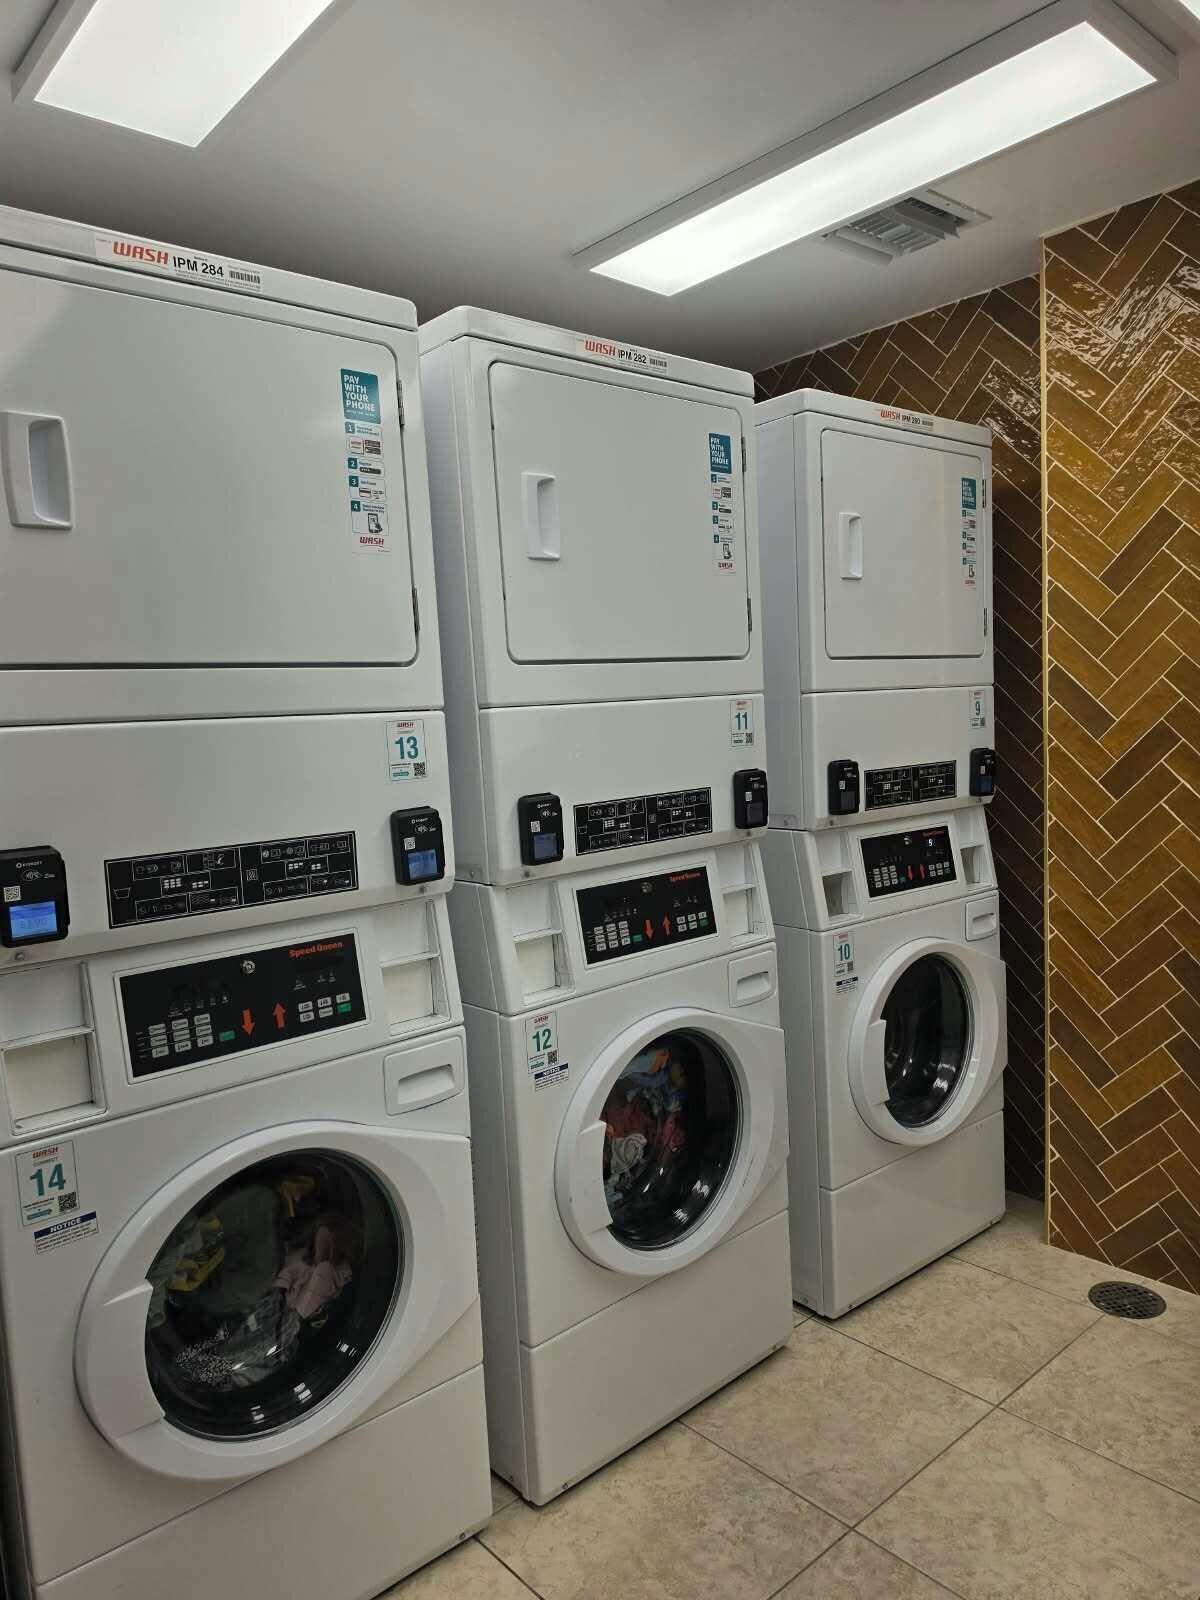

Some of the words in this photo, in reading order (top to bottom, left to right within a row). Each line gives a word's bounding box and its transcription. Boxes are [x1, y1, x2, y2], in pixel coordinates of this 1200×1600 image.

[113, 241, 169, 265] WASH
[173, 256, 198, 272] IPM
[201, 262, 224, 278] 284
[584, 340, 616, 356] WASH
[617, 348, 632, 361] IPM
[633, 353, 647, 364] 282
[343, 374, 360, 385] PAY
[344, 382, 367, 394] WITH
[344, 390, 369, 403] YOUR
[346, 399, 375, 412] PHONE
[880, 409, 901, 421] WASH
[359, 536, 385, 545] WASH
[975, 700, 981, 716] 9
[735, 711, 748, 730] 11
[394, 736, 419, 759] 13
[837, 943, 851, 961] 10
[532, 1028, 552, 1052] 12
[29, 1163, 67, 1196] 14
[50, 1217, 82, 1233] NOTICE
